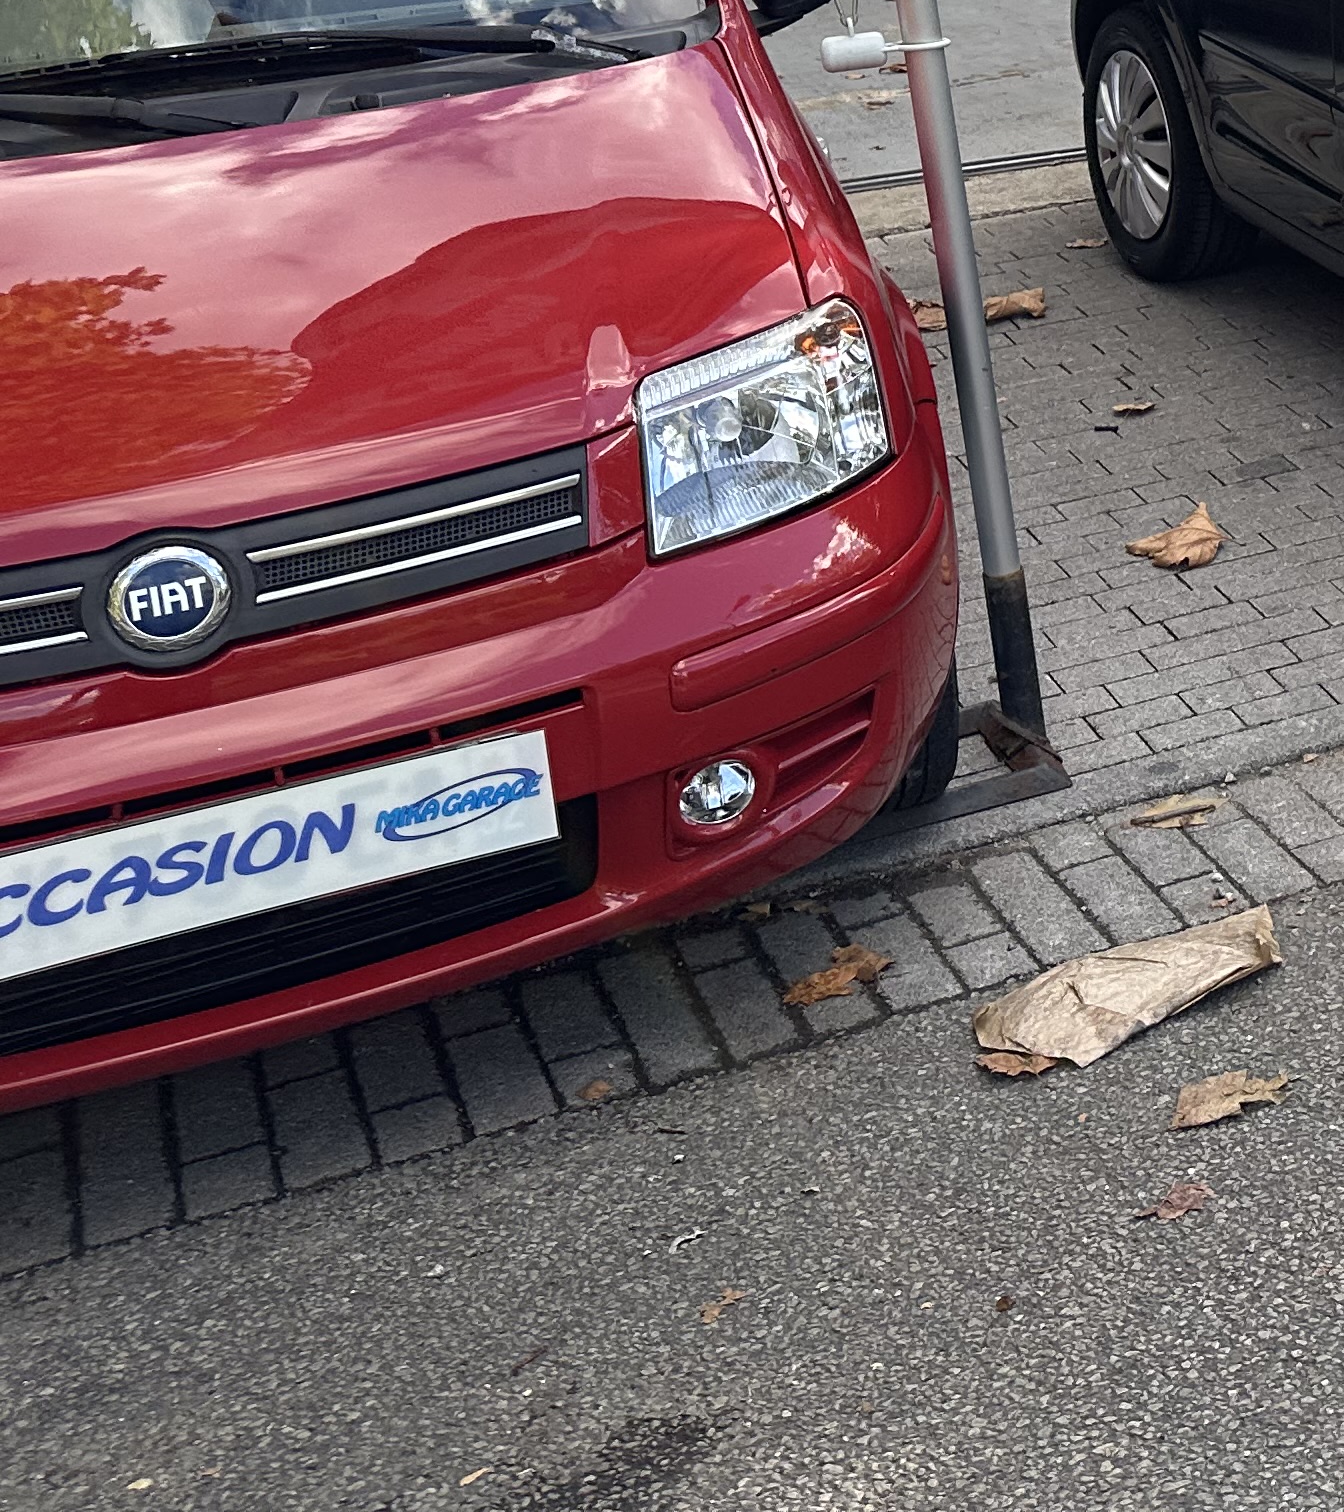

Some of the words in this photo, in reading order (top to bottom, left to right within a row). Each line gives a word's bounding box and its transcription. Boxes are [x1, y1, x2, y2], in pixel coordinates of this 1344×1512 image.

[129, 576, 206, 622] FIAT
[375, 798, 440, 833] MIKA
[441, 773, 544, 817] GARAGE
